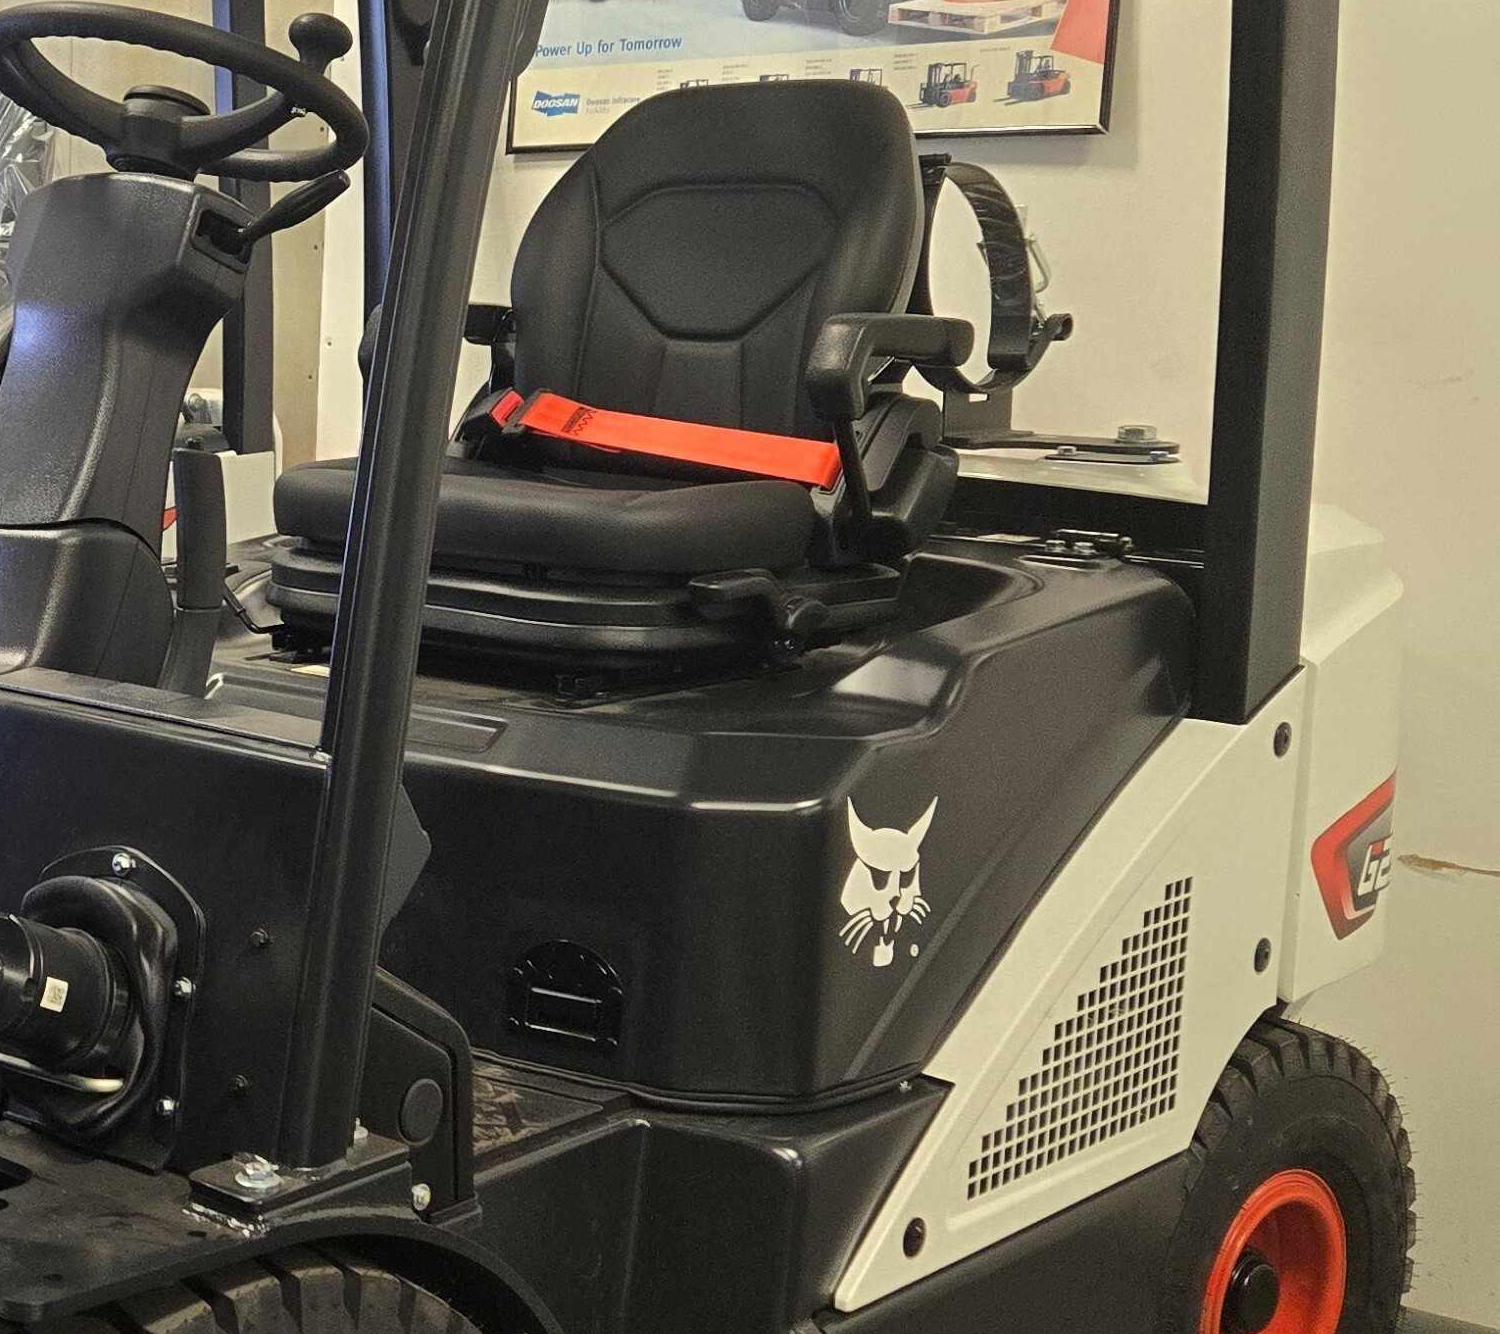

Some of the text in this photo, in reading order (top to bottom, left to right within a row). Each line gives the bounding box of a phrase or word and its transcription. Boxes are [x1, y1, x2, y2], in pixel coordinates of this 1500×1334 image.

[535, 37, 683, 58] Power Up for Tomorrow
[533, 98, 578, 109] DOOSAN
